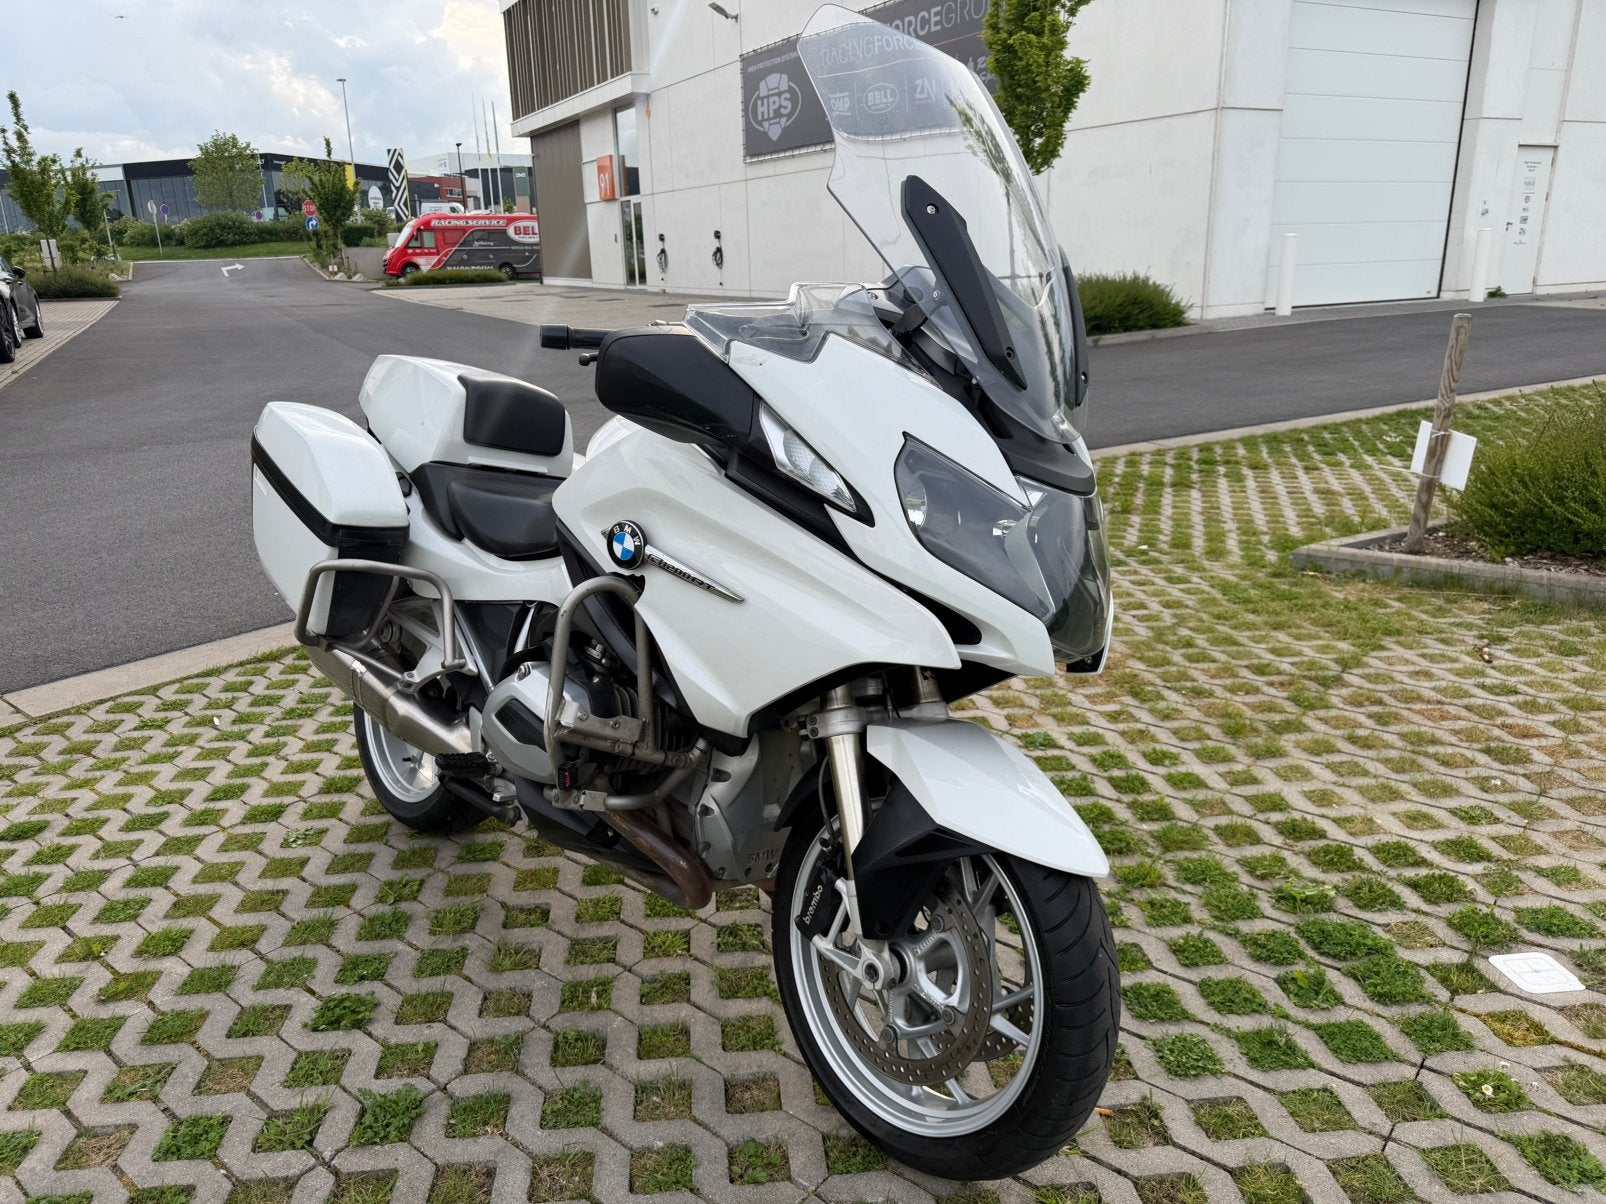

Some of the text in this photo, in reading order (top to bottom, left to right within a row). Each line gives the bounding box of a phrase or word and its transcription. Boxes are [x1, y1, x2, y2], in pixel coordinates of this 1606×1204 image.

[757, 92, 792, 120] HPS
[867, 89, 894, 106] BELL
[613, 524, 641, 546] BMW
[648, 553, 716, 591] R1200RT
[747, 848, 779, 864] BMW
[803, 885, 823, 926] brembo
